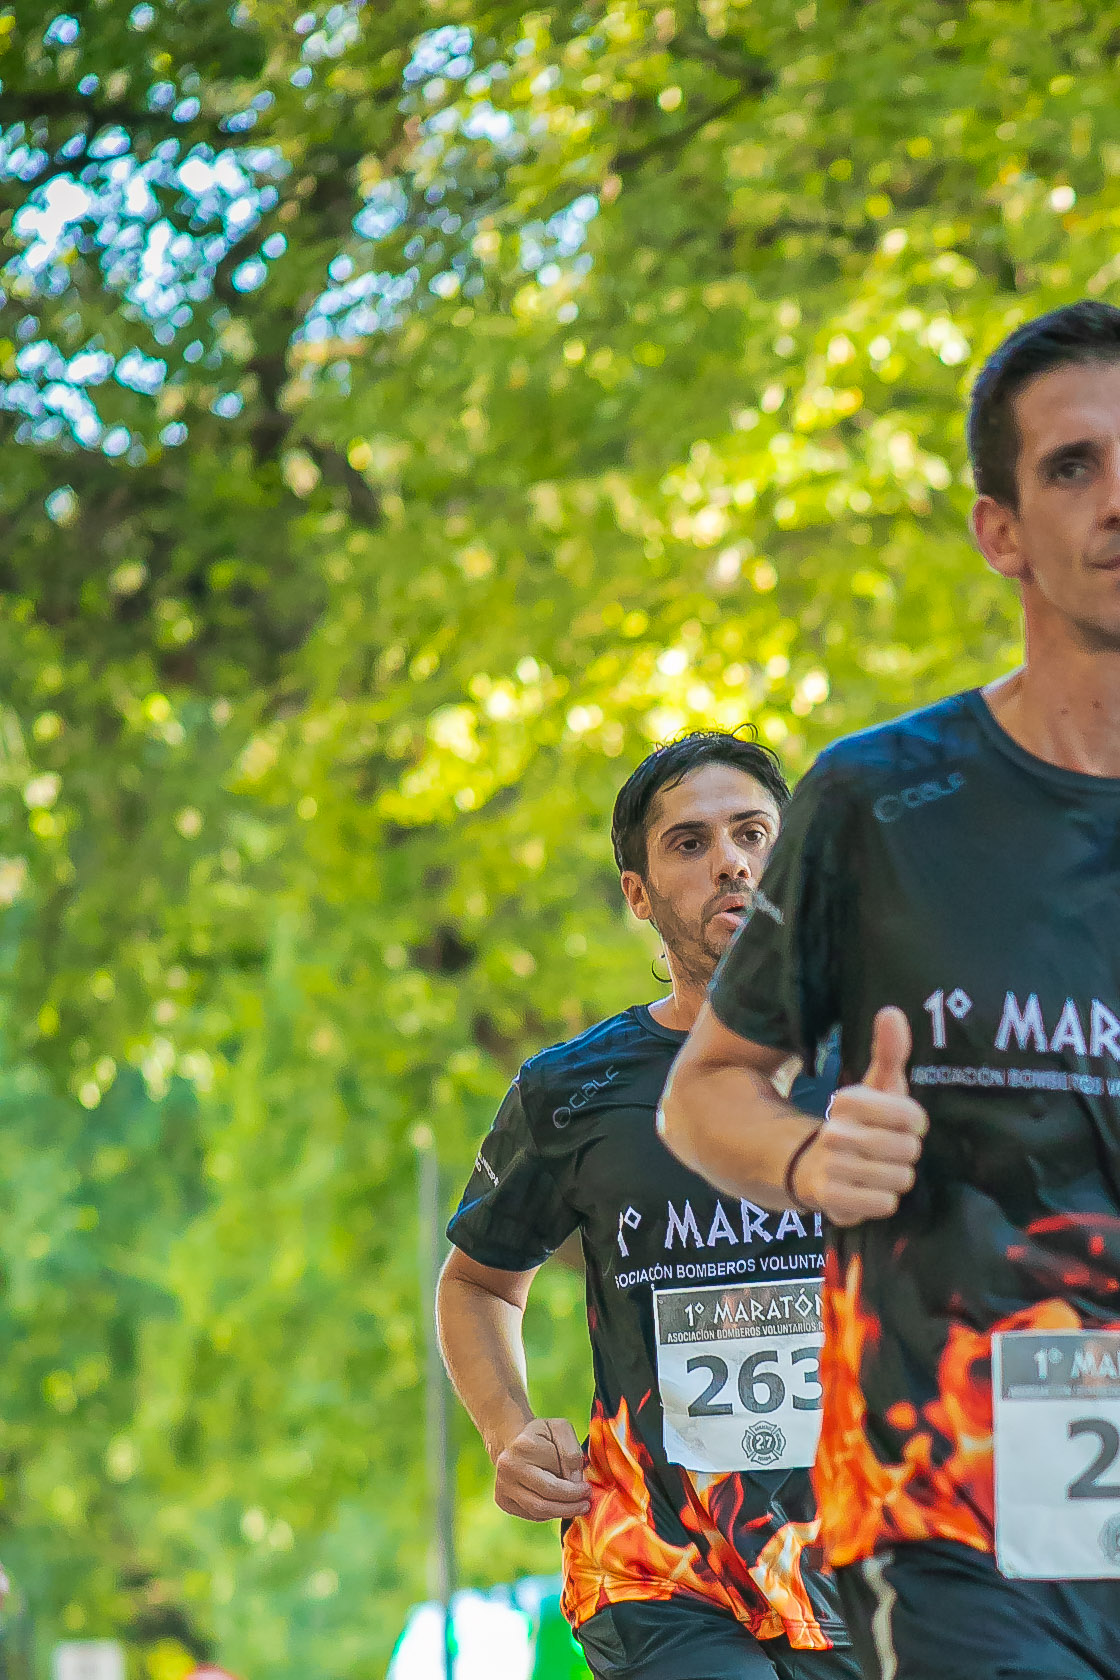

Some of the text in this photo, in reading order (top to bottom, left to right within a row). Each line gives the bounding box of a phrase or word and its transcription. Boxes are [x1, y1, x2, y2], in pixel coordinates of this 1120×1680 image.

[676, 1258, 756, 1279] BOMBEROS
[716, 1324, 761, 1340] BOMBEROS
[762, 1321, 817, 1336] VOLUNTARIOS
[686, 1346, 824, 1418] 263
[755, 1434, 773, 1450] 27
